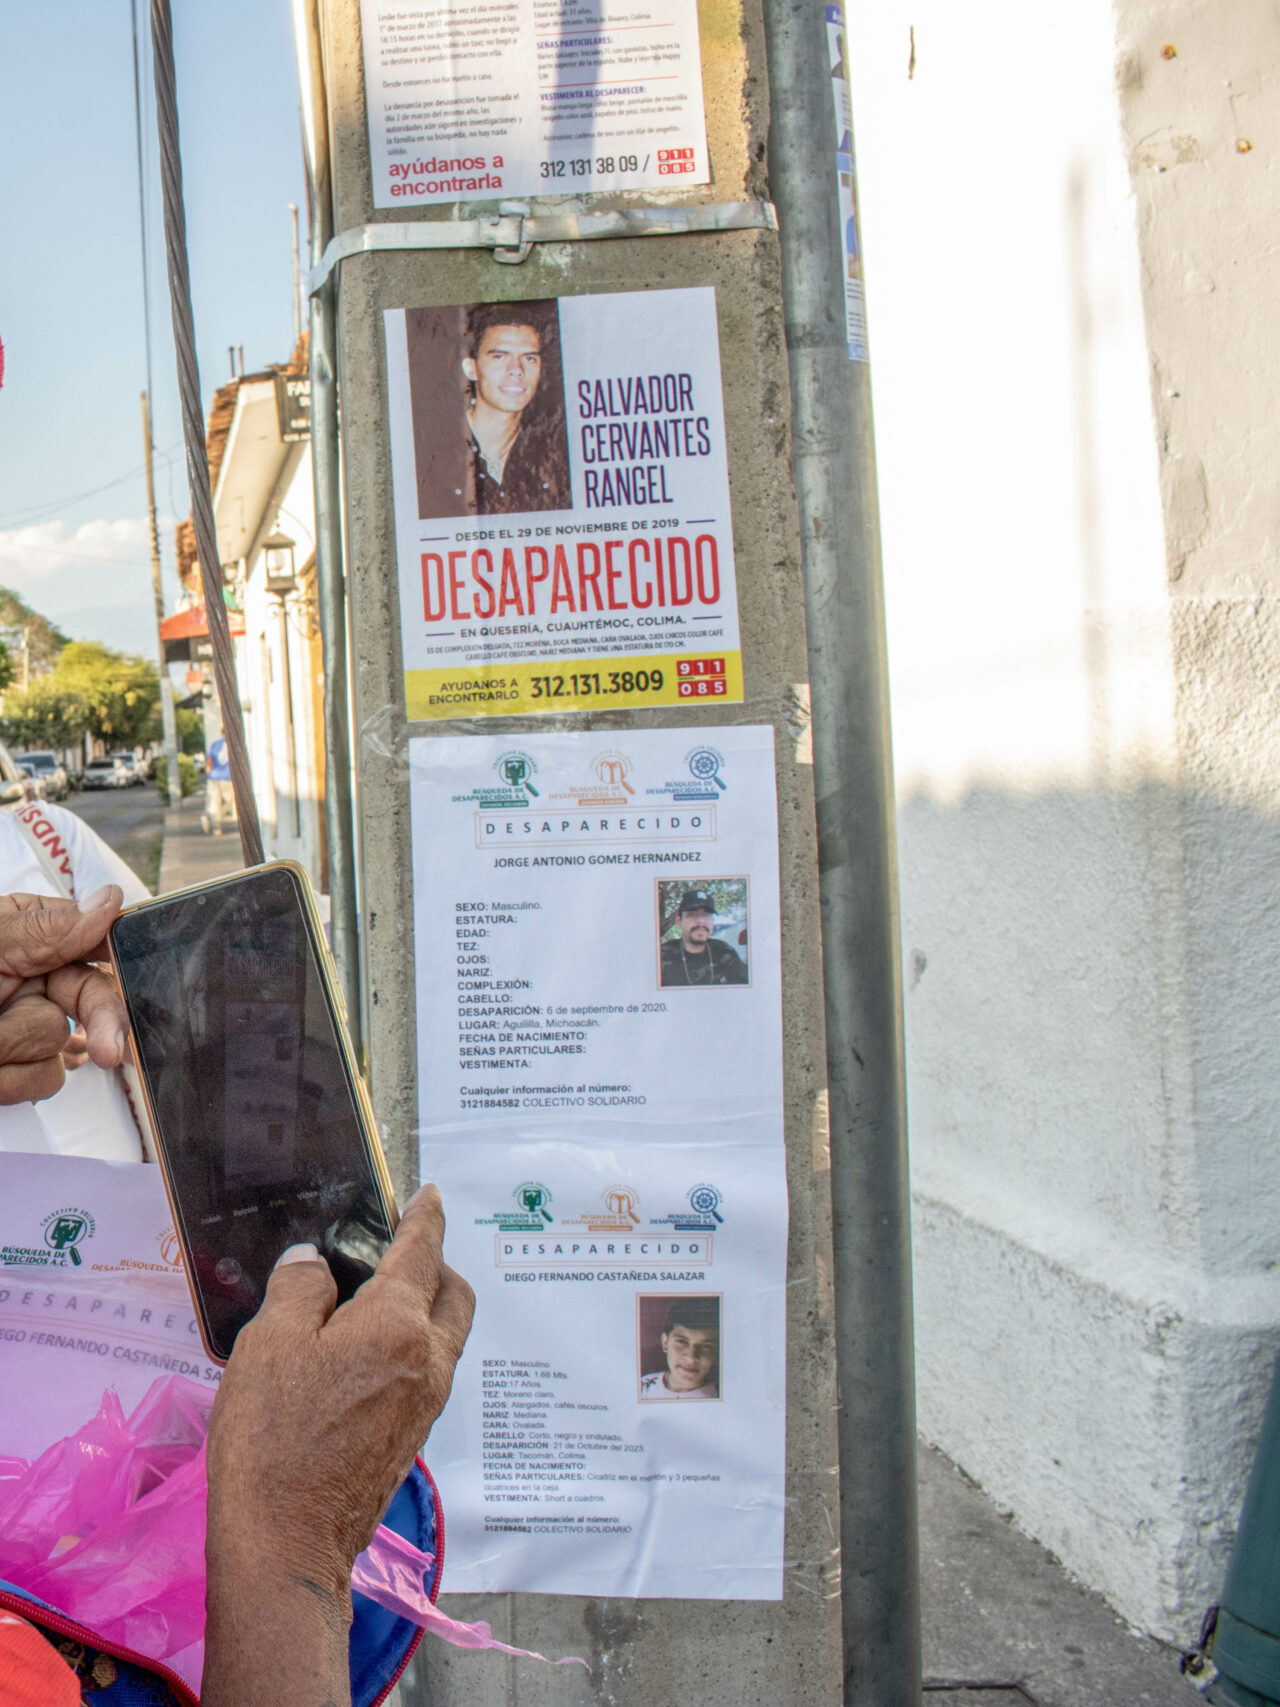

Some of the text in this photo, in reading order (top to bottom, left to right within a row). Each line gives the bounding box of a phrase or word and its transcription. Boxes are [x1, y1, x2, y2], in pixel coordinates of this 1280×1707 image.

[540, 91, 583, 100] VESTIMENTA
[389, 156, 504, 180] ayúdanos a
[540, 160, 565, 178] 312
[569, 158, 591, 176] 131
[596, 157, 615, 174] 38
[618, 155, 638, 172] 09
[390, 172, 502, 196] encontrarla
[577, 373, 693, 419] SALVADOR
[581, 416, 710, 464] CERVANTES
[584, 465, 673, 508] RANGEL
[455, 518, 679, 542] DESDE EL 29 DE NOVIEMBRE DE 2019
[421, 534, 720, 622] DESAPARECIDO
[460, 615, 686, 638] EN QUESERÍA, CUAUHTÉMOC, COLIMA.
[440, 679, 518, 692] AYUDANOS A
[530, 669, 663, 698] 312.131.3809
[428, 690, 518, 704] ENCONTRARLO
[486, 816, 701, 834] DESAPARECIDO
[494, 852, 701, 868] JORGE ANTONIO GOMEZ HERNANDEZ
[455, 902, 488, 912] SEXO:
[456, 914, 517, 925] ESTATURA:
[456, 928, 489, 938] EDAD:
[456, 941, 479, 951] TEZ:
[456, 954, 489, 964] OJOS:
[457, 968, 492, 977] NARIZ:
[457, 978, 532, 990] COMPLEXIÓN:
[457, 993, 512, 1004] CABELLO:
[458, 1004, 542, 1016] DESAPARICIÓN:
[546, 1006, 552, 1015] 6
[555, 1006, 567, 1014] de
[570, 1004, 623, 1015] septiembre
[626, 1004, 639, 1012] de
[458, 1020, 500, 1030] LUGAR:
[459, 1031, 587, 1042] FECHA DE NACIMIENTO:
[459, 1044, 585, 1056] SEÑAS PARTICULARES:
[459, 1059, 531, 1069] VESTIMENTA:
[460, 1083, 631, 1096] Cualquier información al número:
[460, 1095, 646, 1108] 3121884582 COLECTIVO SOLIDARIO
[2, 1245, 66, 1258] BÚSQUEDA DE
[504, 1243, 698, 1254] DESAPARECIDO
[504, 1270, 704, 1282] DIEGO FERNANDO CASTAÑEDA SALAZAR
[29, 1332, 109, 1356] FERNANDO
[113, 1346, 199, 1377] CASTAÑEDA
[554, 1433, 577, 1442] negro
[578, 1434, 583, 1442] y
[576, 1442, 608, 1450] Octubre
[514, 1462, 526, 1470] DE
[484, 1472, 584, 1481] SEÑAS PARTICULARES:
[484, 1494, 541, 1502] VESTIMENTA:
[544, 1494, 564, 1502] Short
[485, 1516, 523, 1524] Cualquier
[526, 1515, 575, 1523] información
[533, 1525, 583, 1533] COLECTIVO
